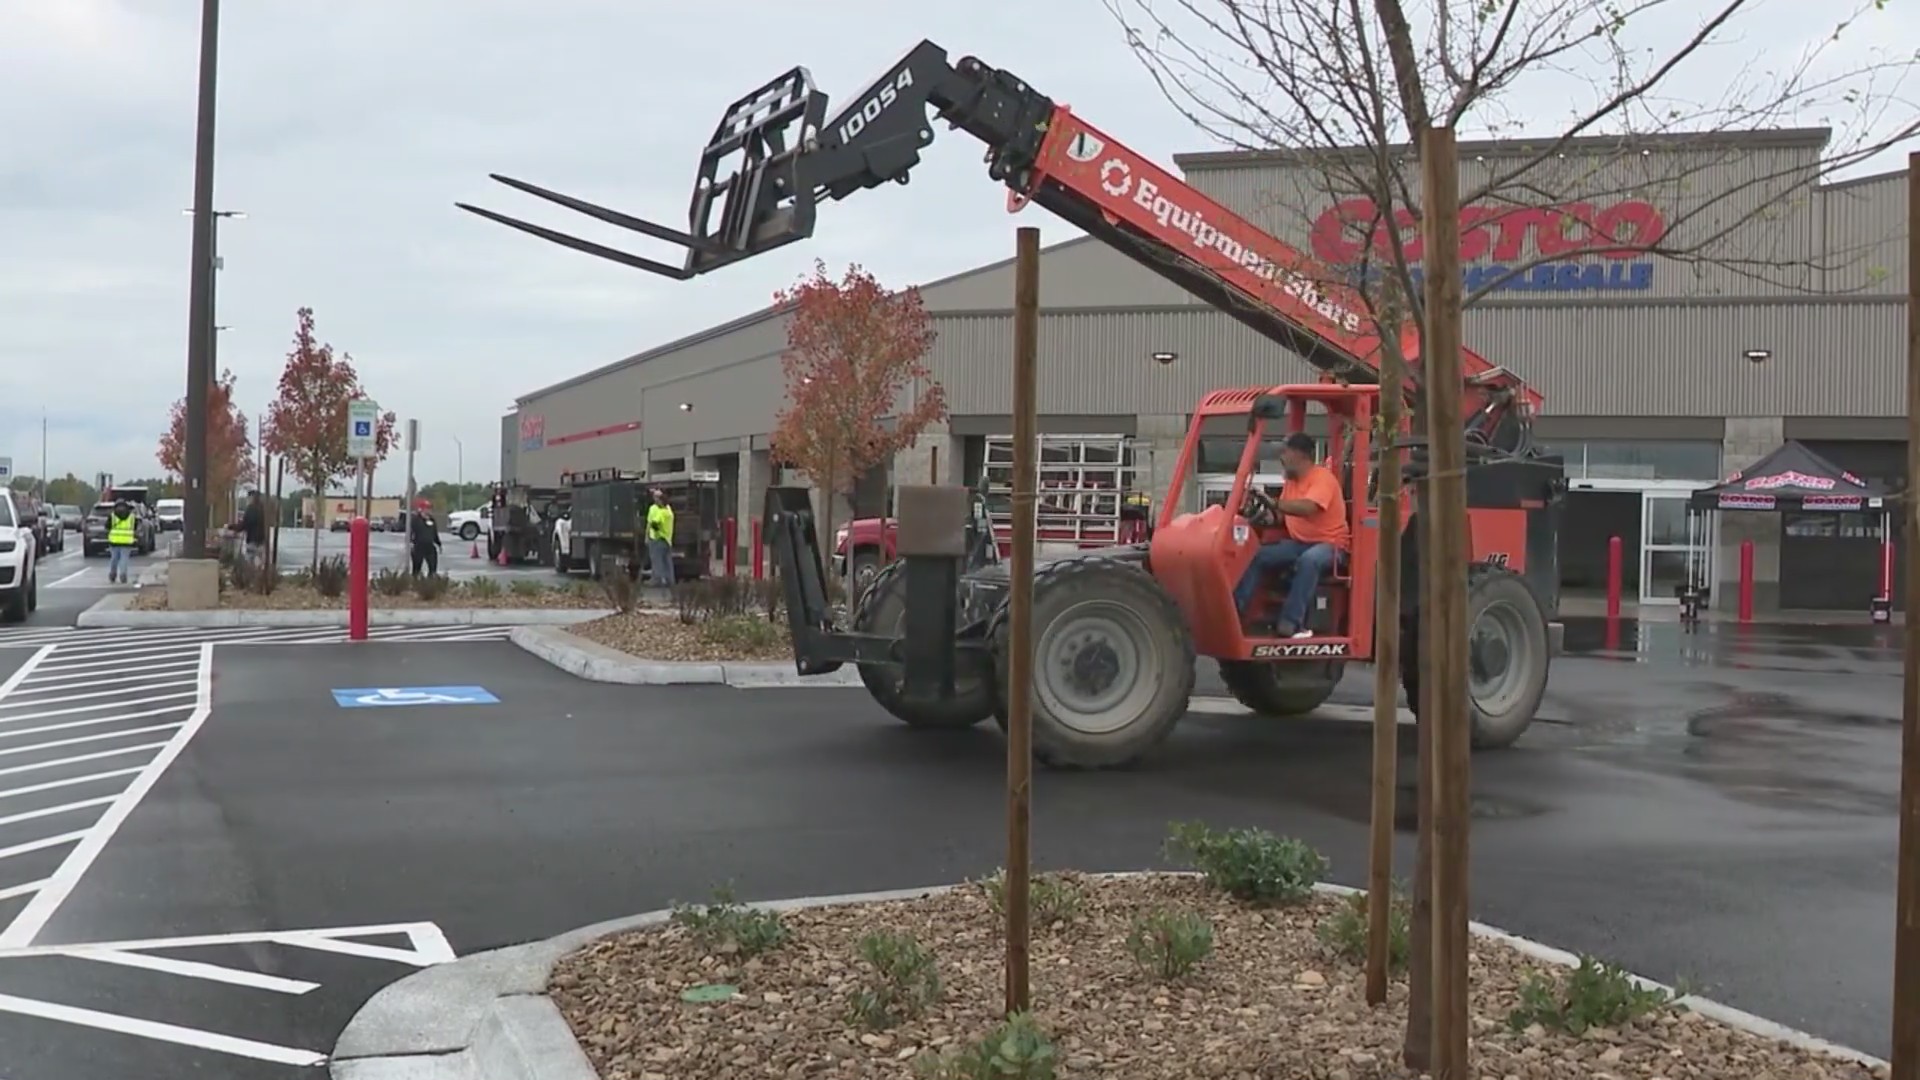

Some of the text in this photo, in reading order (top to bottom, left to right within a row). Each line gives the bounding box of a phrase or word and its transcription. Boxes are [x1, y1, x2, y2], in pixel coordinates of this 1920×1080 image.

[838, 67, 914, 144] 10054
[1411, 263, 1653, 293] HOLESALE
[1255, 643, 1346, 657] SKYTRAK
